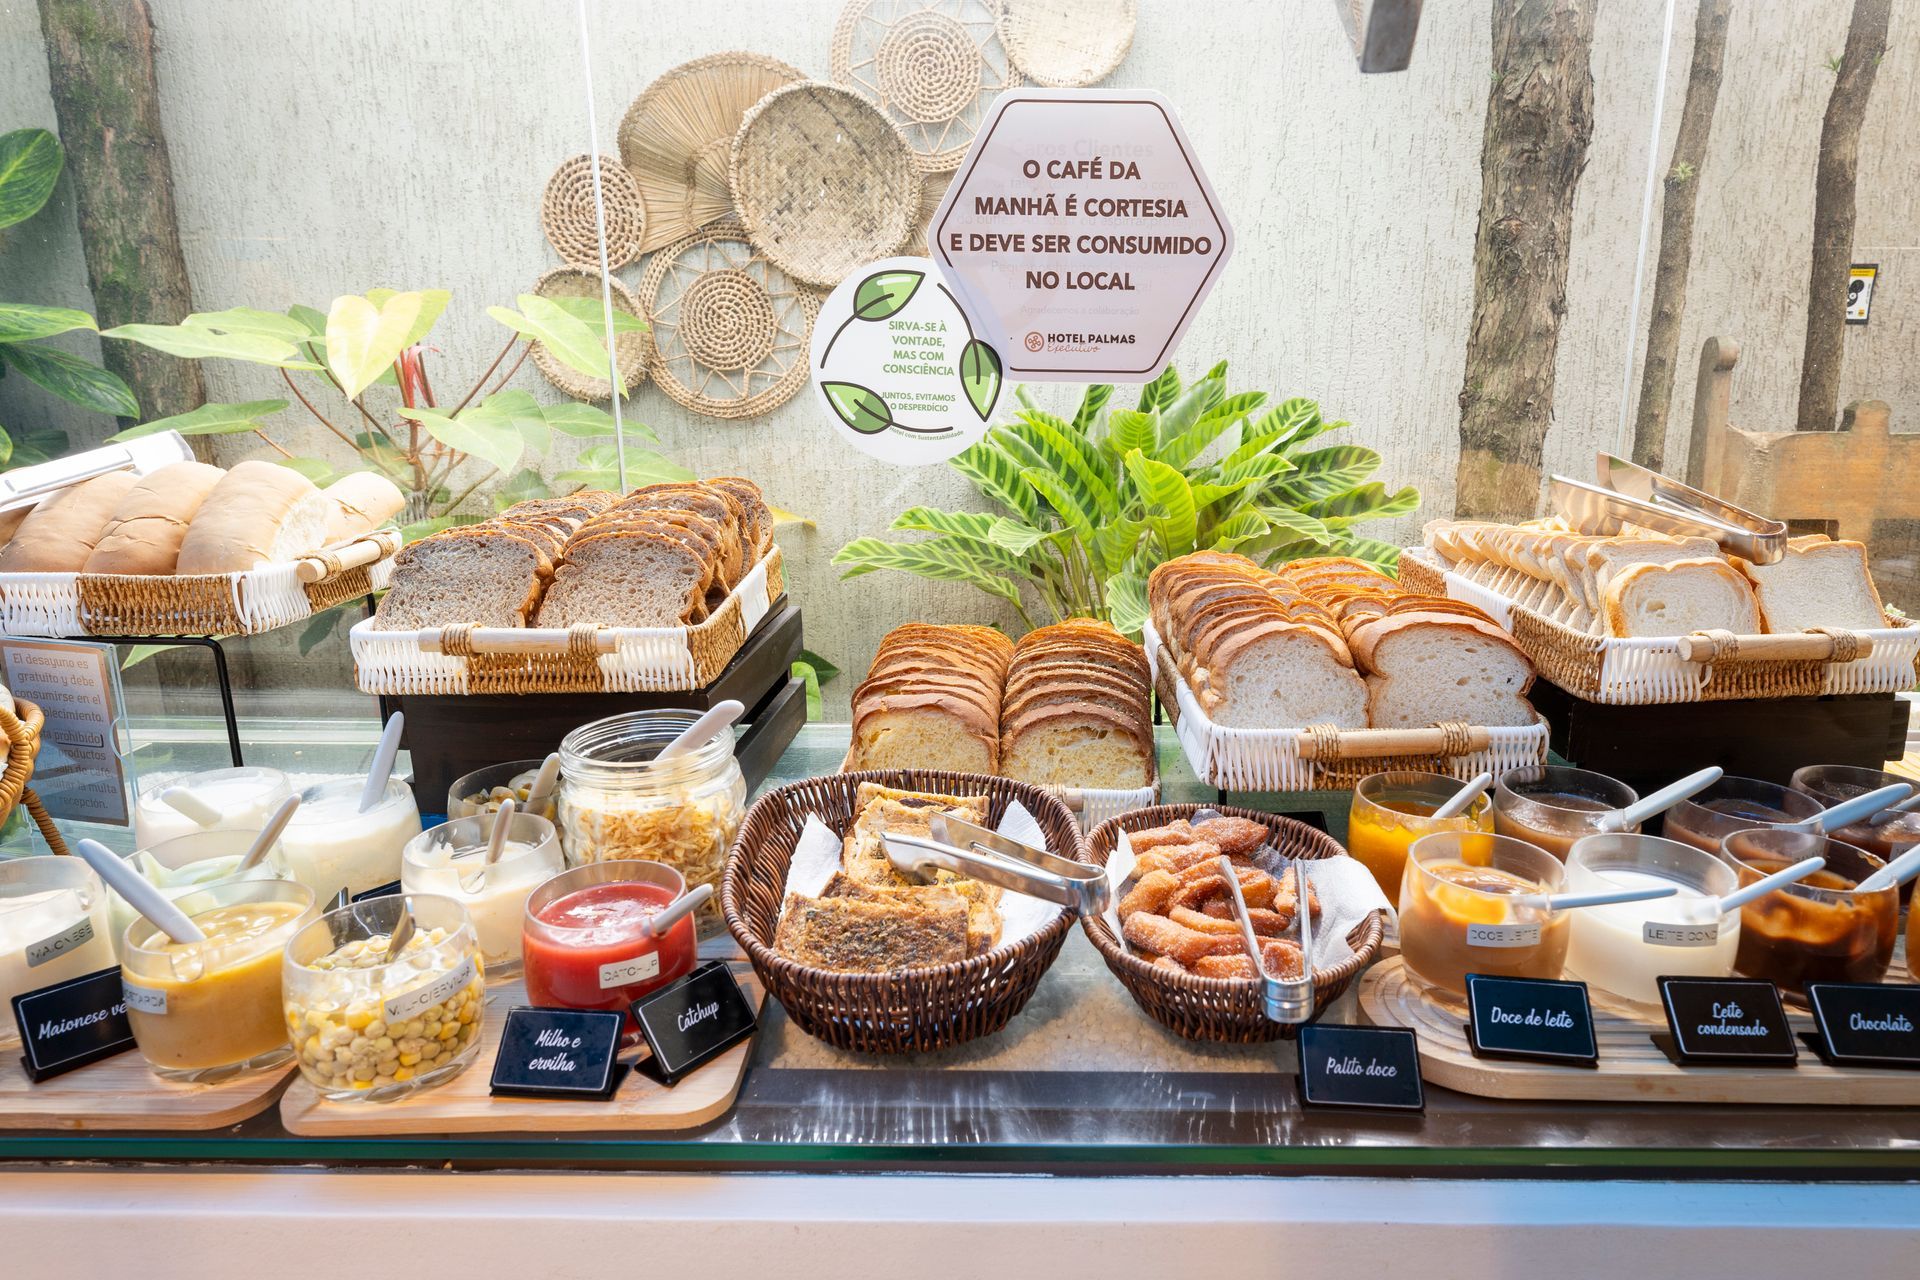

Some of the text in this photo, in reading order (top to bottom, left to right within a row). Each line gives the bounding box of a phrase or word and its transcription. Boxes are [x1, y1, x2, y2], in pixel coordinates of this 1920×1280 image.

[1022, 156, 1142, 180] O CAFÉ DA
[974, 193, 1189, 218] MANHÃ É CORTESIA
[950, 233, 1213, 256] E DEVE SER CONSUMIDO
[1025, 271, 1060, 290] NO
[1066, 271, 1136, 291] LOCAL
[888, 320, 947, 332] SIRVA-SE À
[892, 335, 946, 348] VONTADE,
[1047, 333, 1136, 344] HOTEL PALMAS
[893, 350, 945, 361] MAS COM
[882, 363, 955, 376] CONSCIÊNCIA
[881, 391, 956, 402] JUNTOS, EVITAMOS
[890, 402, 949, 412] O DESPERDÍCIO
[12, 653, 89, 669] El desayuno es
[17, 671, 95, 687] gratuito y debe
[14, 689, 102, 705] consumirse en el
[54, 730, 100, 744] prohibido
[88, 782, 118, 794] multa
[677, 999, 721, 1033] Catchup
[1491, 1006, 1575, 1029] Doce de leite
[1711, 1002, 1744, 1019] Leite
[38, 1009, 109, 1040] Maionese
[1696, 1018, 1769, 1037] condensado
[1850, 1013, 1914, 1032] Chocolate
[534, 1029, 582, 1049] Milho e
[529, 1050, 576, 1073] ervilha
[1326, 1056, 1397, 1078] Palito doce
